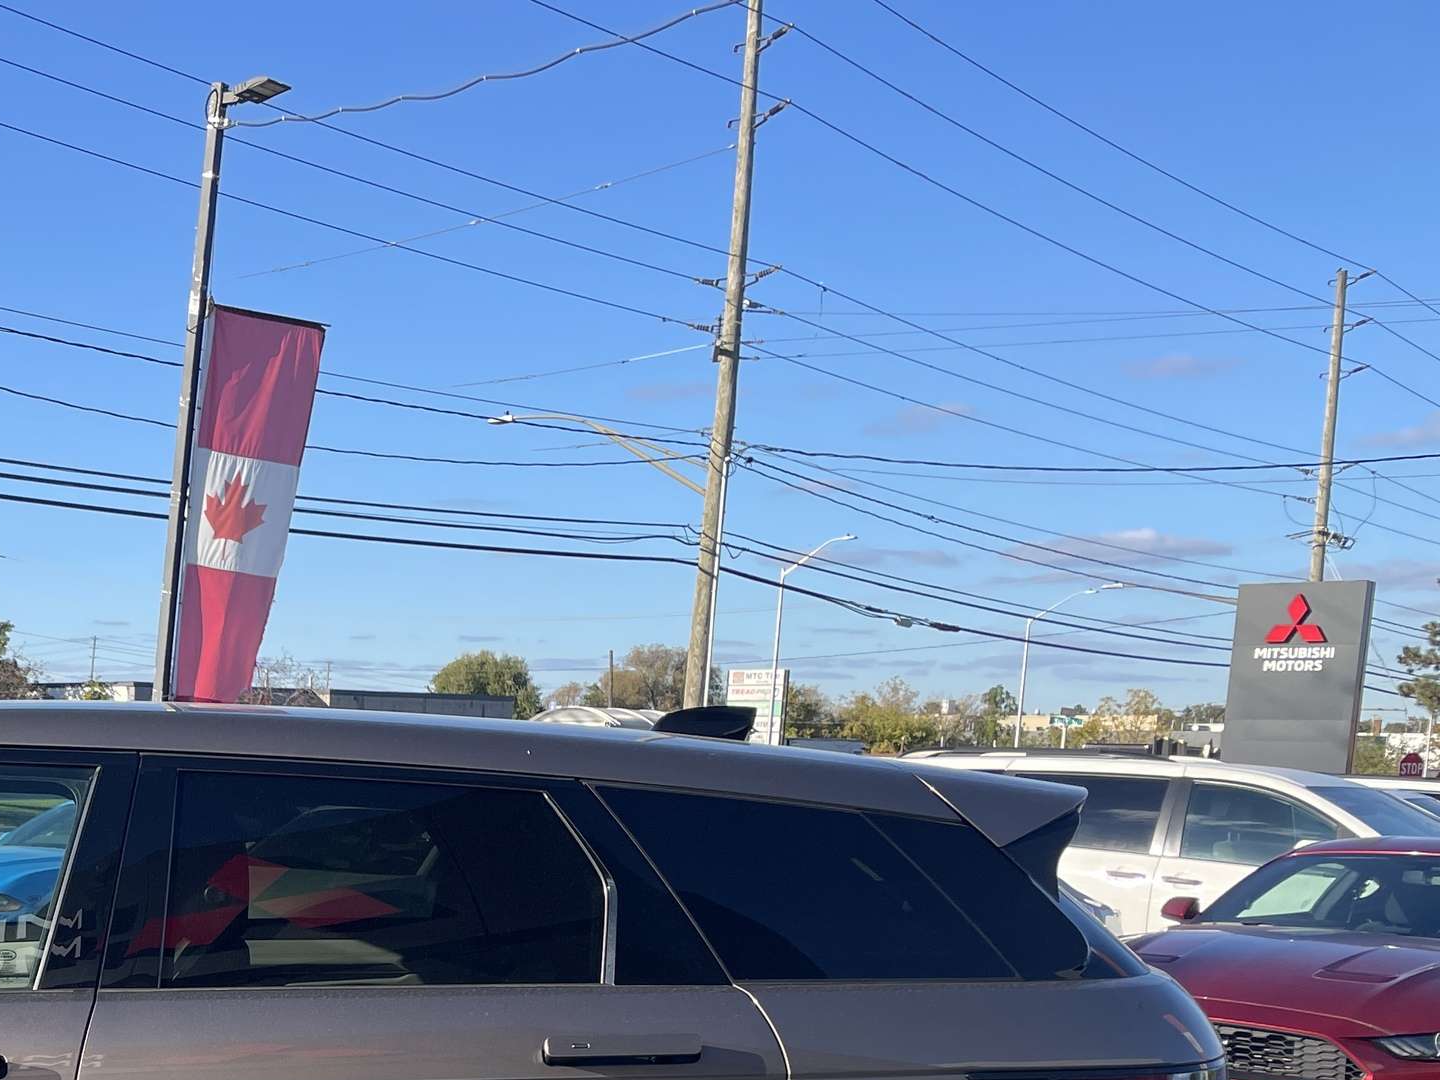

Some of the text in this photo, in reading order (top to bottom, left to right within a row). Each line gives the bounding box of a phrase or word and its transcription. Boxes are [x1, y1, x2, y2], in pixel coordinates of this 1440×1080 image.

[1253, 647, 1336, 660] MITSUBISHI
[1262, 660, 1323, 672] MOTORS
[1400, 762, 1424, 776] STOP
